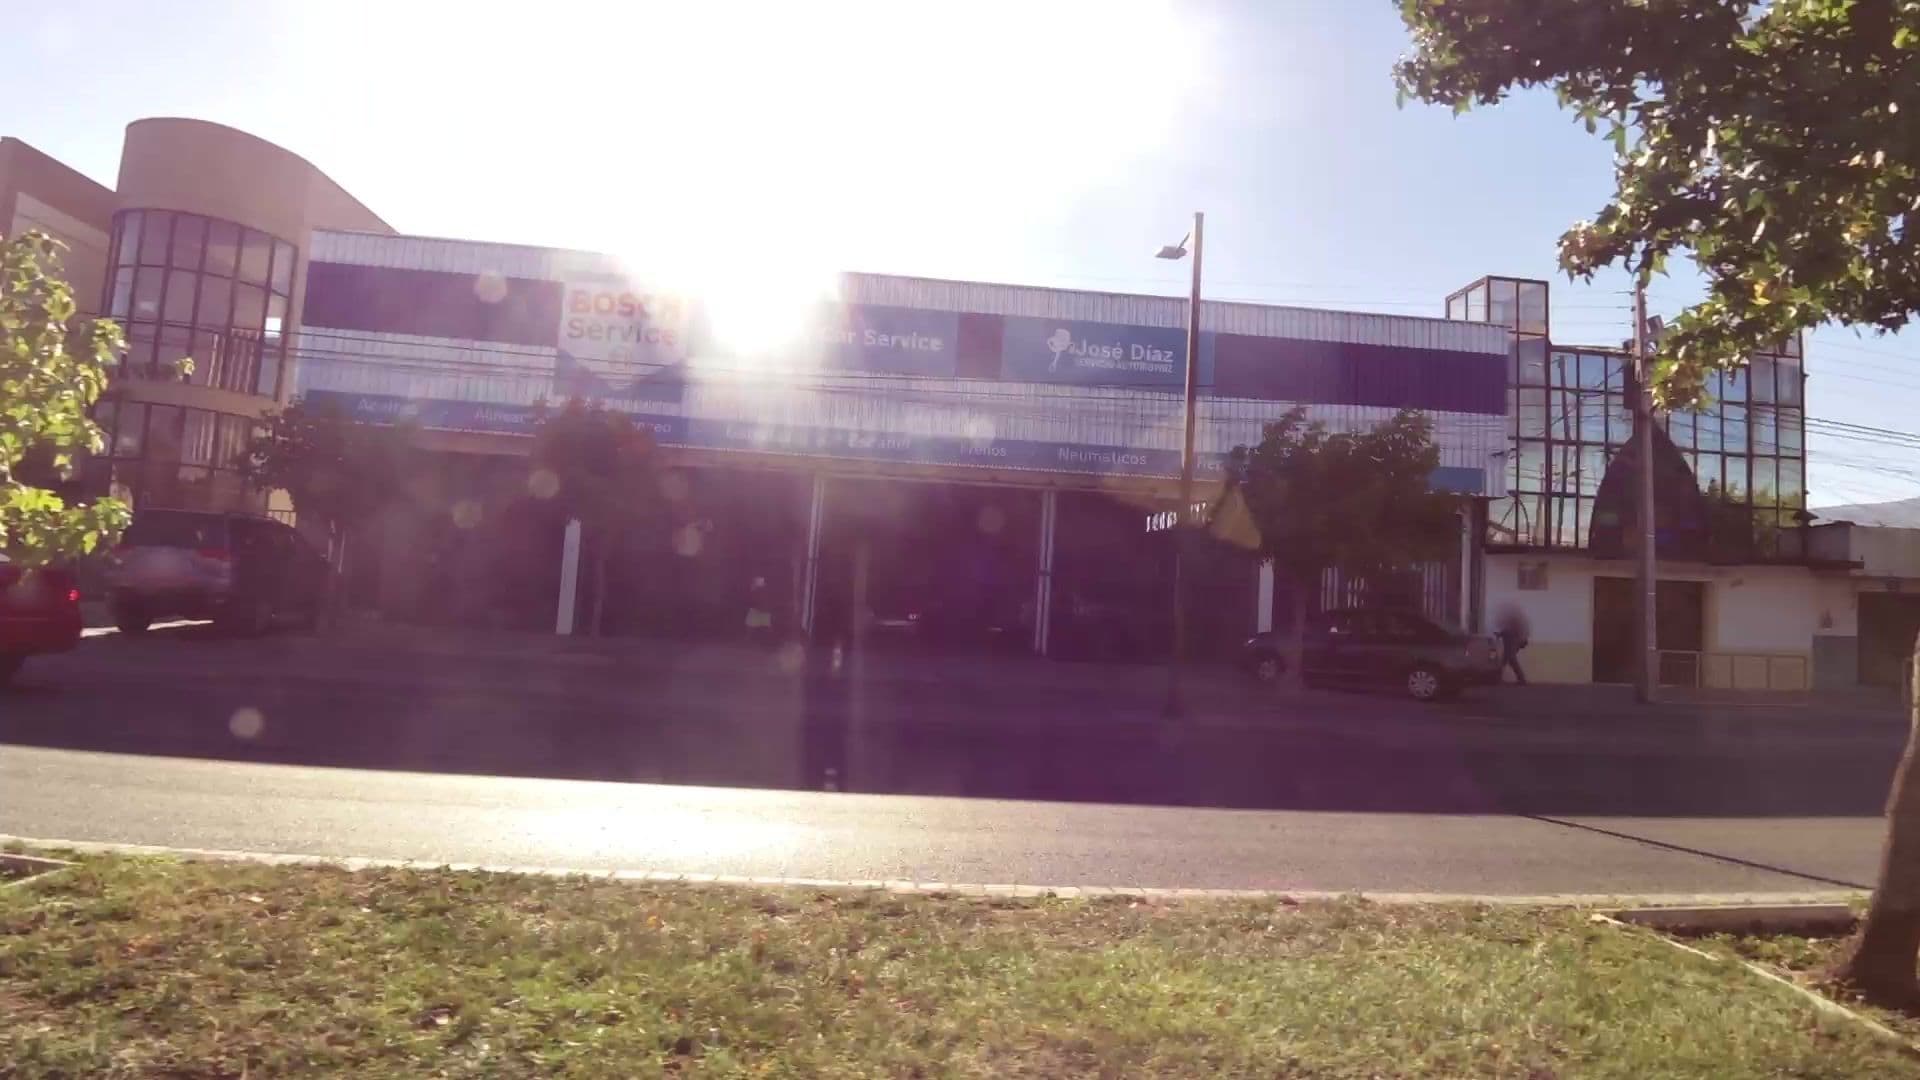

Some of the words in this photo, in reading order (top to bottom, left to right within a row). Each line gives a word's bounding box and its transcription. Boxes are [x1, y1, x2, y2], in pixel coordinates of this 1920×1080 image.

[566, 318, 680, 346] Service
[863, 328, 945, 351] Service
[1075, 337, 1124, 359] José
[1130, 343, 1174, 363] Díaz
